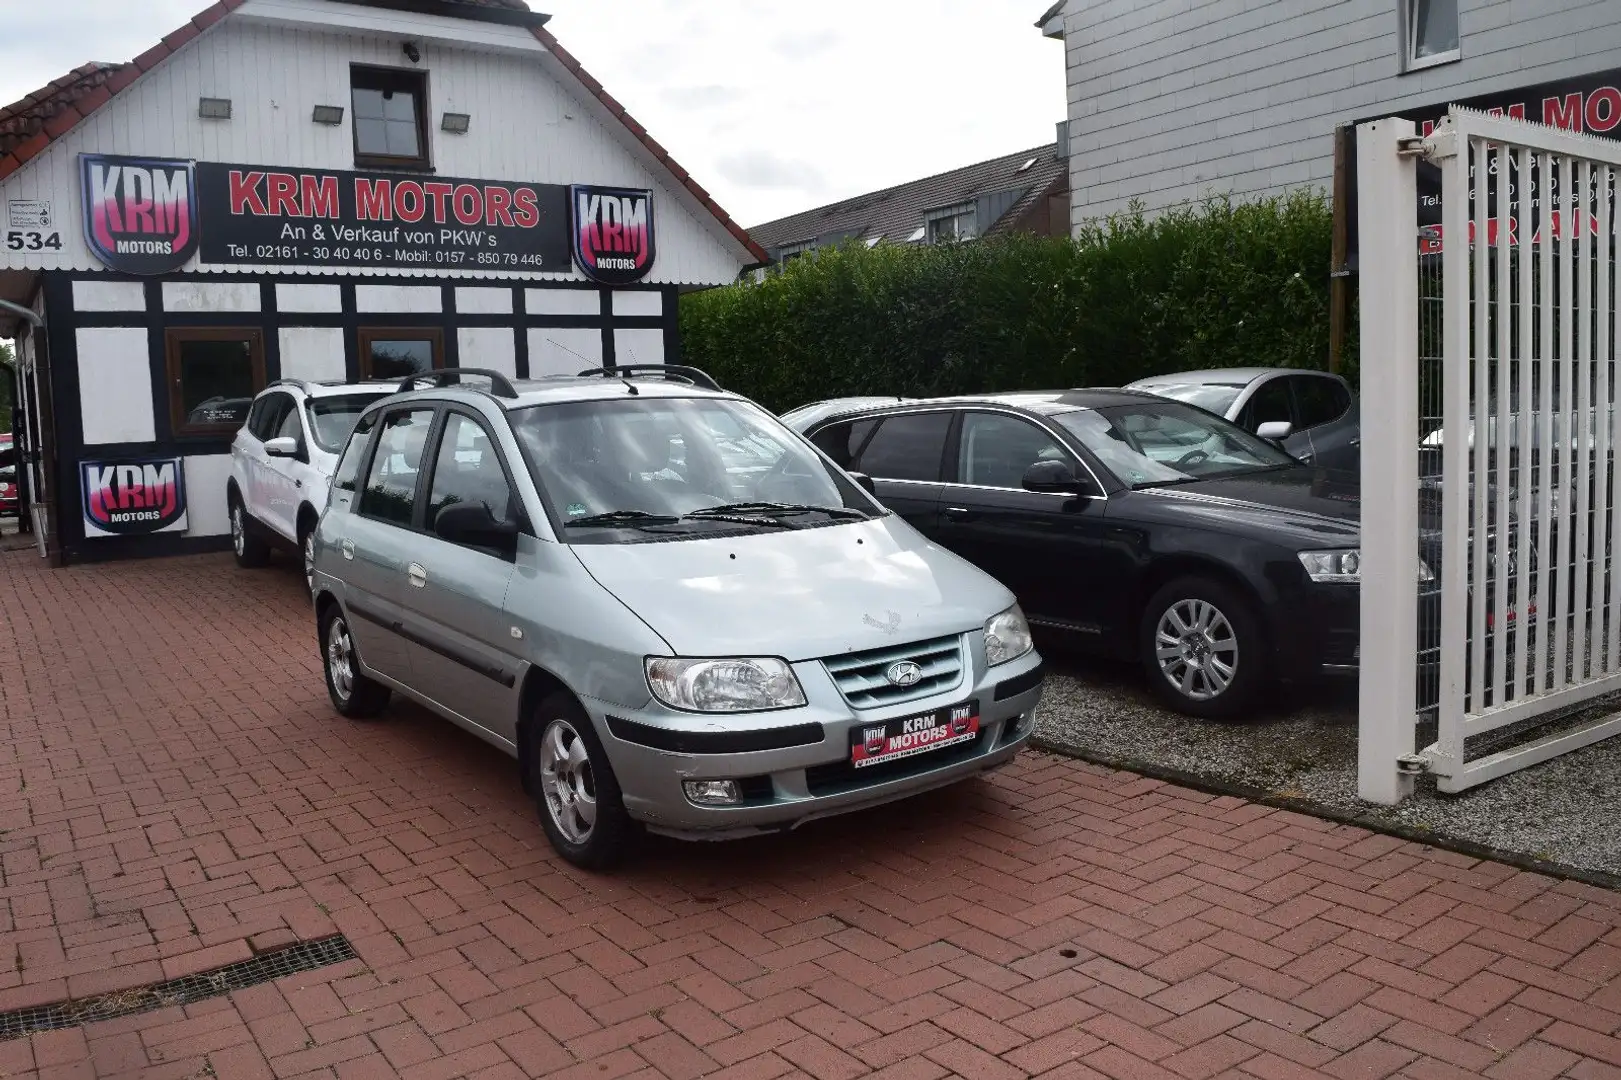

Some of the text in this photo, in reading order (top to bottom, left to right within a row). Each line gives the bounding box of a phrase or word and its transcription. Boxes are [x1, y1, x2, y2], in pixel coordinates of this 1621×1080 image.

[91, 165, 189, 240] KRM
[229, 170, 540, 229] KRM MOTORS
[280, 223, 306, 240] An
[312, 223, 326, 241] &
[331, 224, 400, 243] Verkauf
[404, 231, 435, 245] von
[580, 193, 647, 256] KRM
[7, 231, 62, 250] 534
[117, 240, 172, 255] MOTORS
[227, 244, 252, 258] Tel.
[256, 245, 298, 259] 02161
[312, 247, 330, 260] 30
[333, 247, 350, 260] 40
[353, 248, 370, 261] 40
[373, 248, 382, 261] 6
[395, 249, 432, 262] Mobil:
[435, 251, 465, 263] 0157
[477, 252, 500, 264] 850
[504, 253, 518, 265] 79
[520, 253, 543, 266] 446
[597, 257, 636, 270] MOTORS
[88, 463, 175, 513] KRM
[111, 510, 160, 523] MOTORS
[903, 714, 936, 734] KRM
[890, 725, 948, 751] MOTORS
